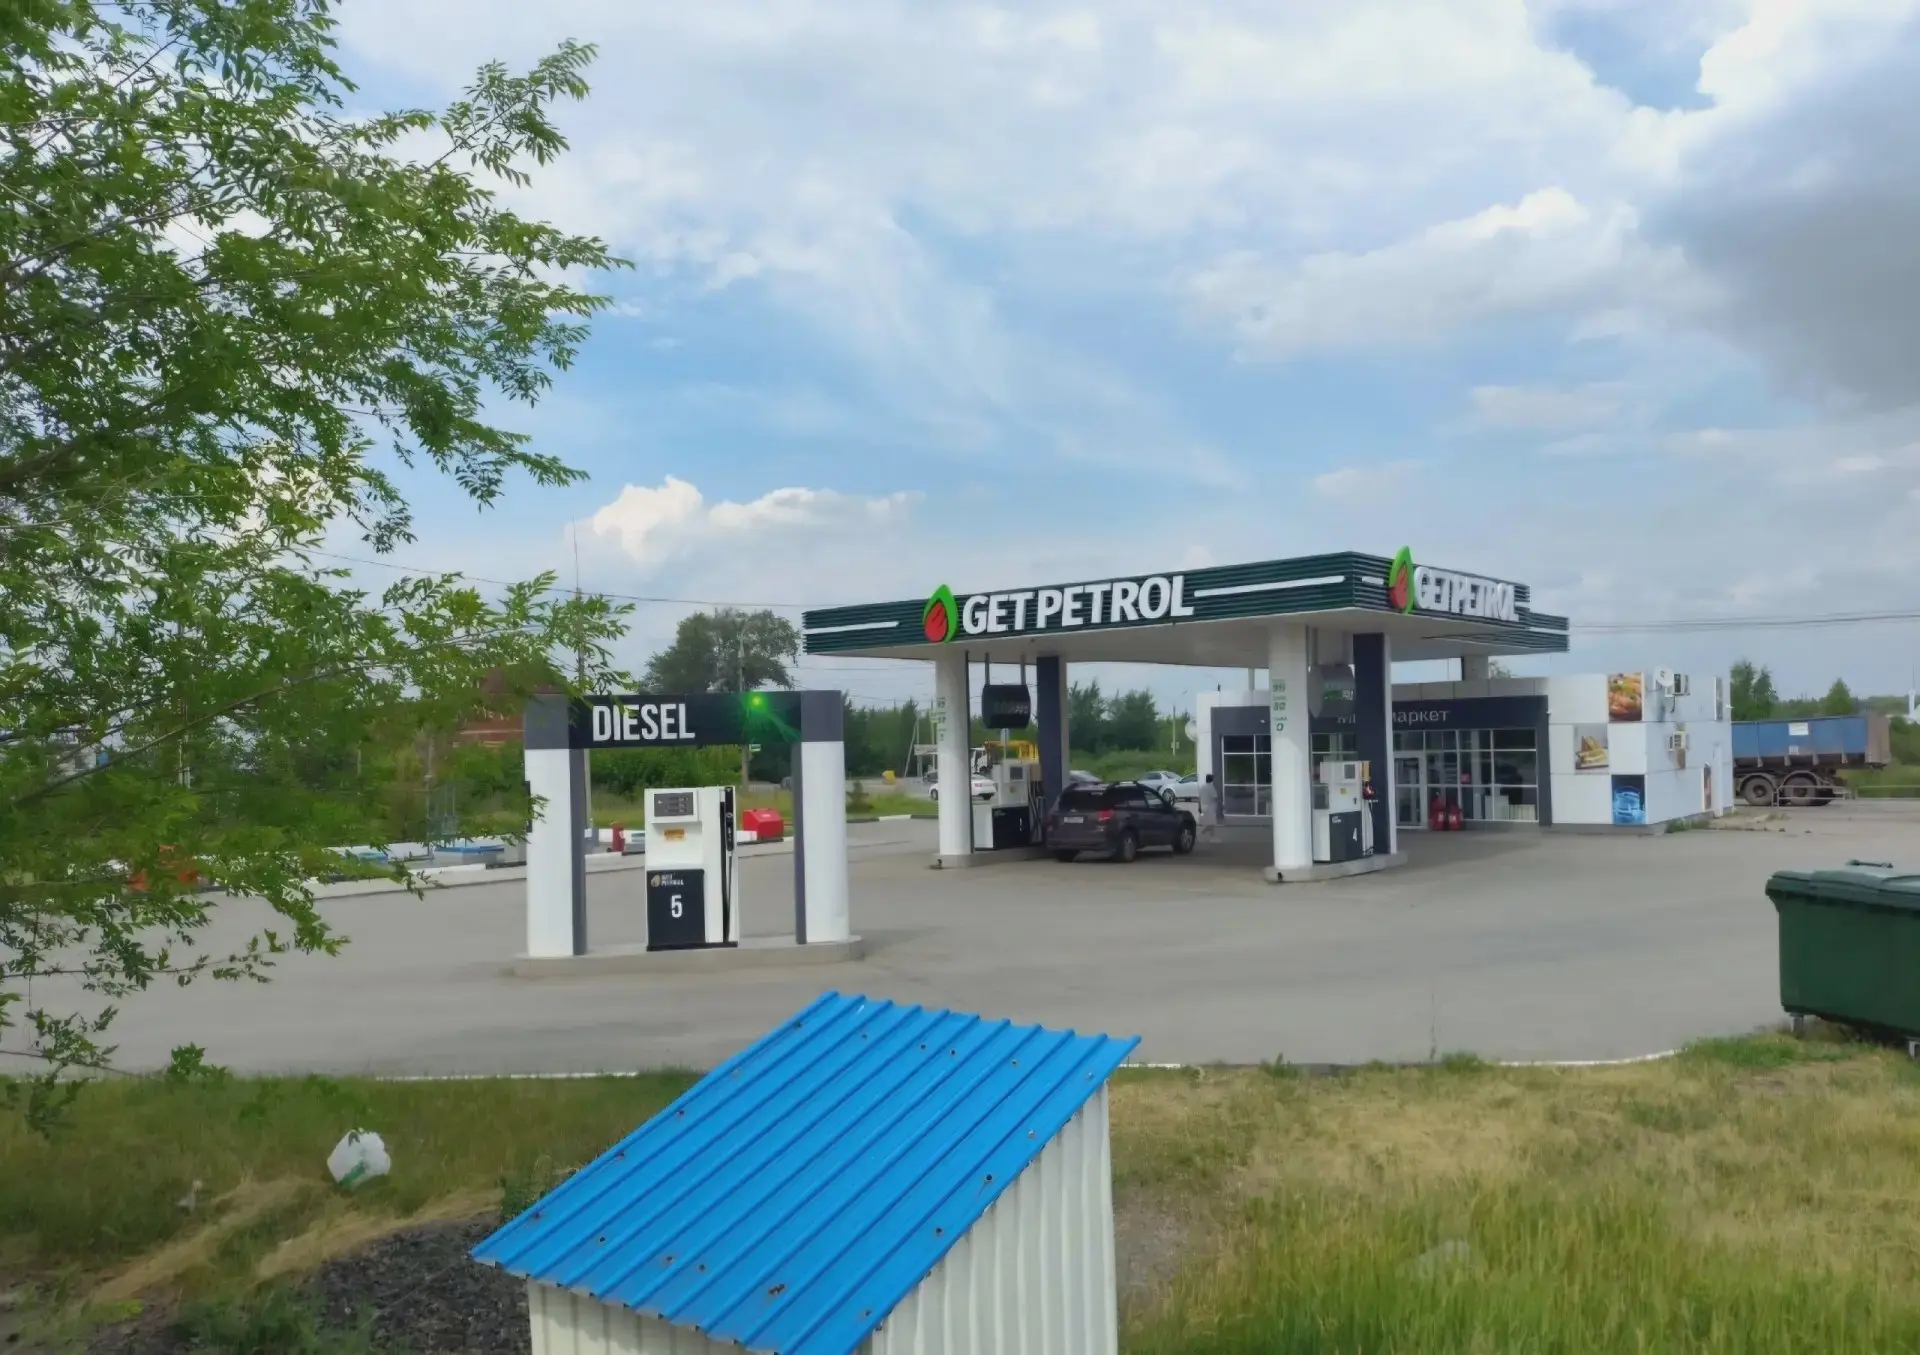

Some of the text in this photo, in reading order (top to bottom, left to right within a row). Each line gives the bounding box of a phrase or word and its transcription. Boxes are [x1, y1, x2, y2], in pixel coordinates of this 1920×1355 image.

[962, 575, 1194, 635] GET PETROL
[1413, 566, 1450, 612] GET
[593, 703, 696, 742] DIESEL
[671, 894, 683, 918] 5
